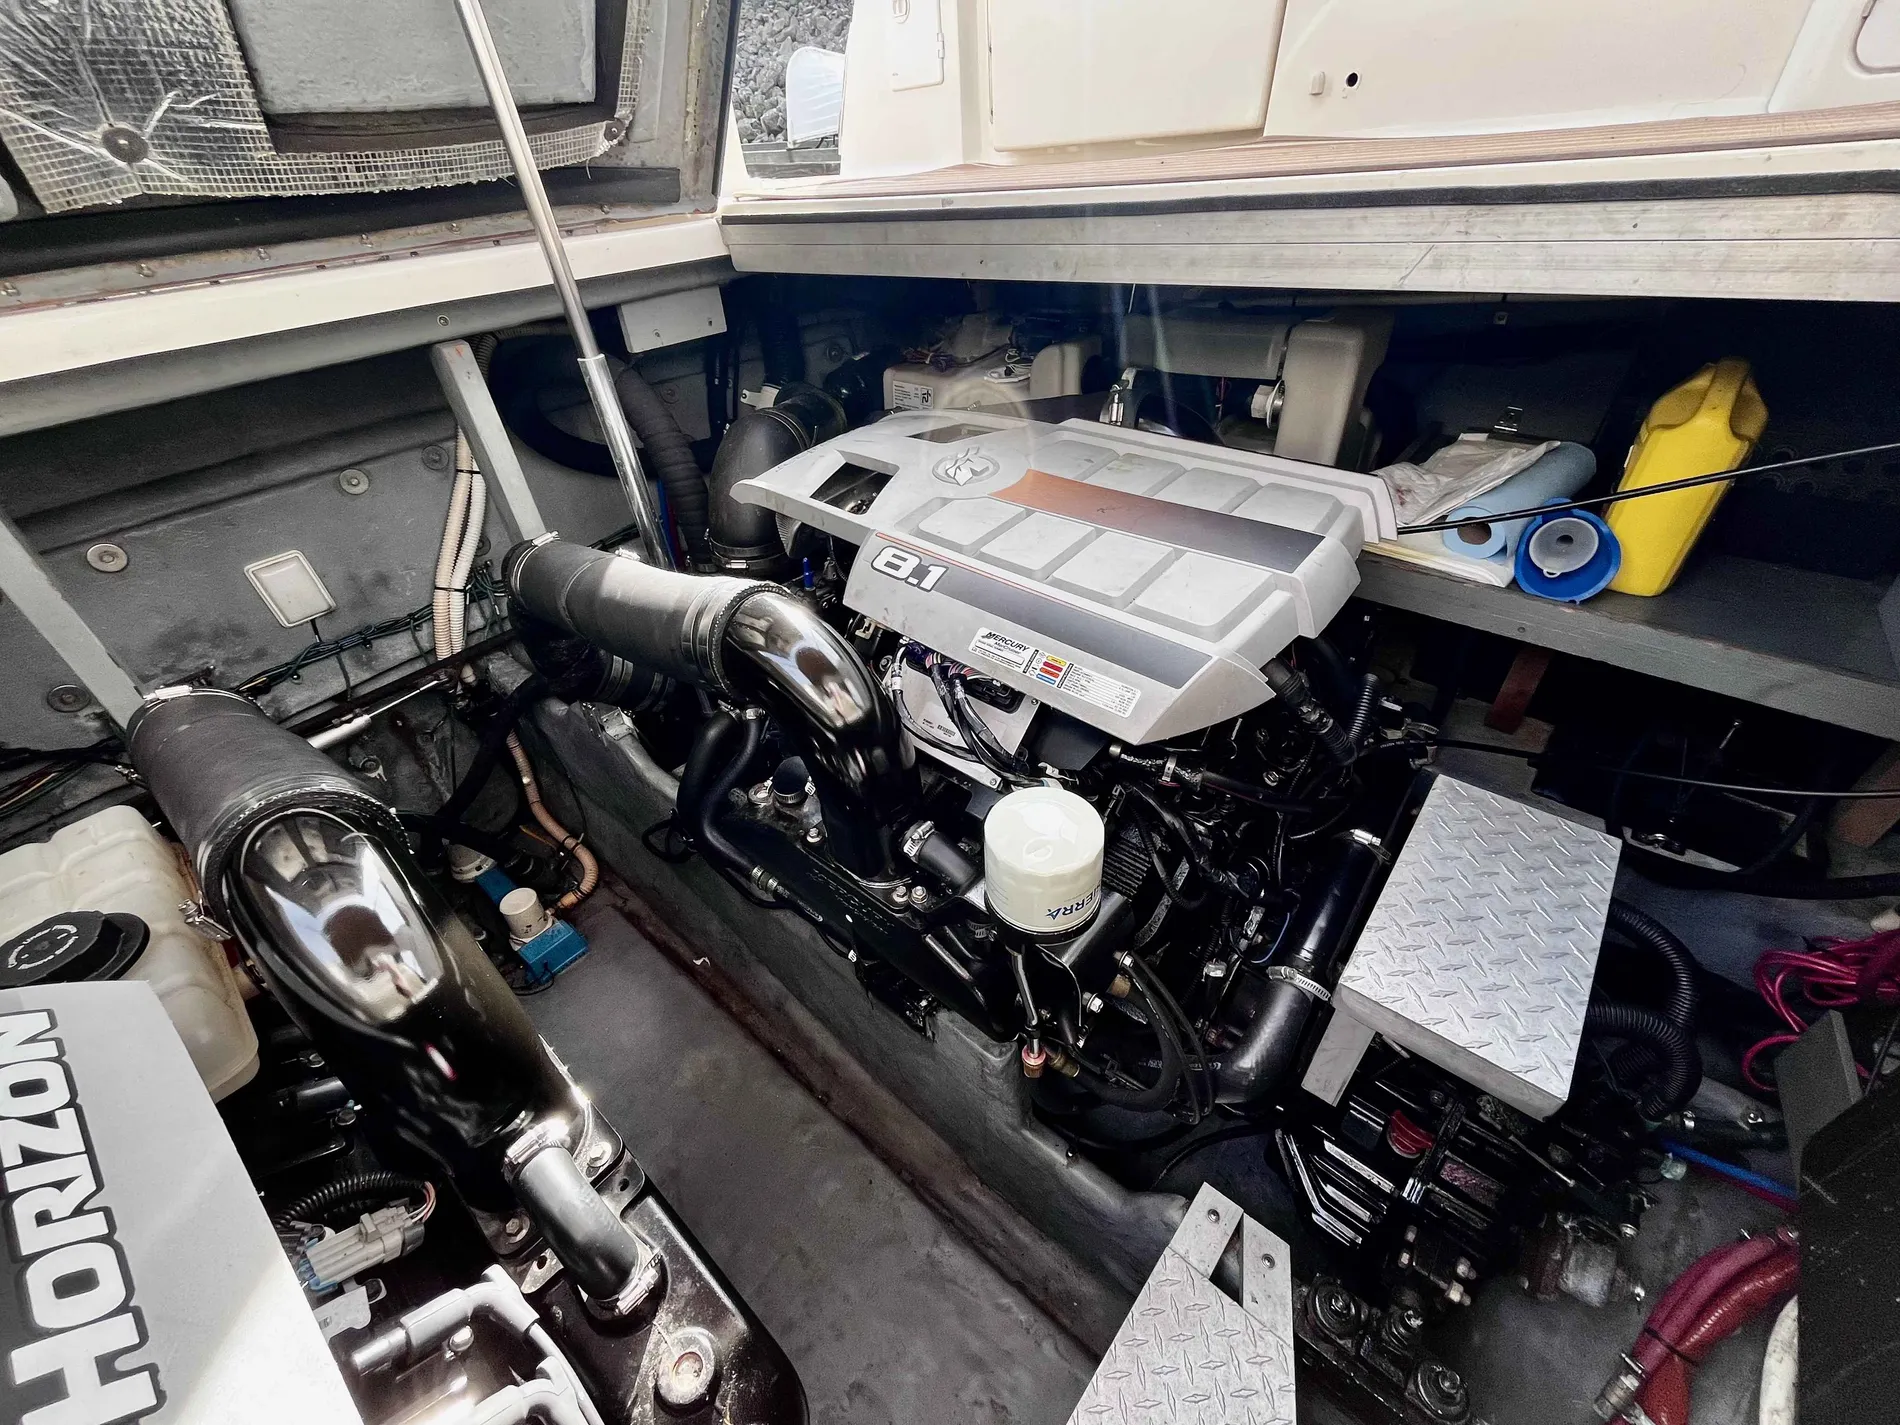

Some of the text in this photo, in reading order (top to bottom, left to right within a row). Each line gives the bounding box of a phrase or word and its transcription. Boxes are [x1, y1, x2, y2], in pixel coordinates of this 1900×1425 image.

[871, 545, 949, 592] 8.1
[985, 631, 1030, 652] MERCURY
[0, 1010, 162, 1425] HORIZON
